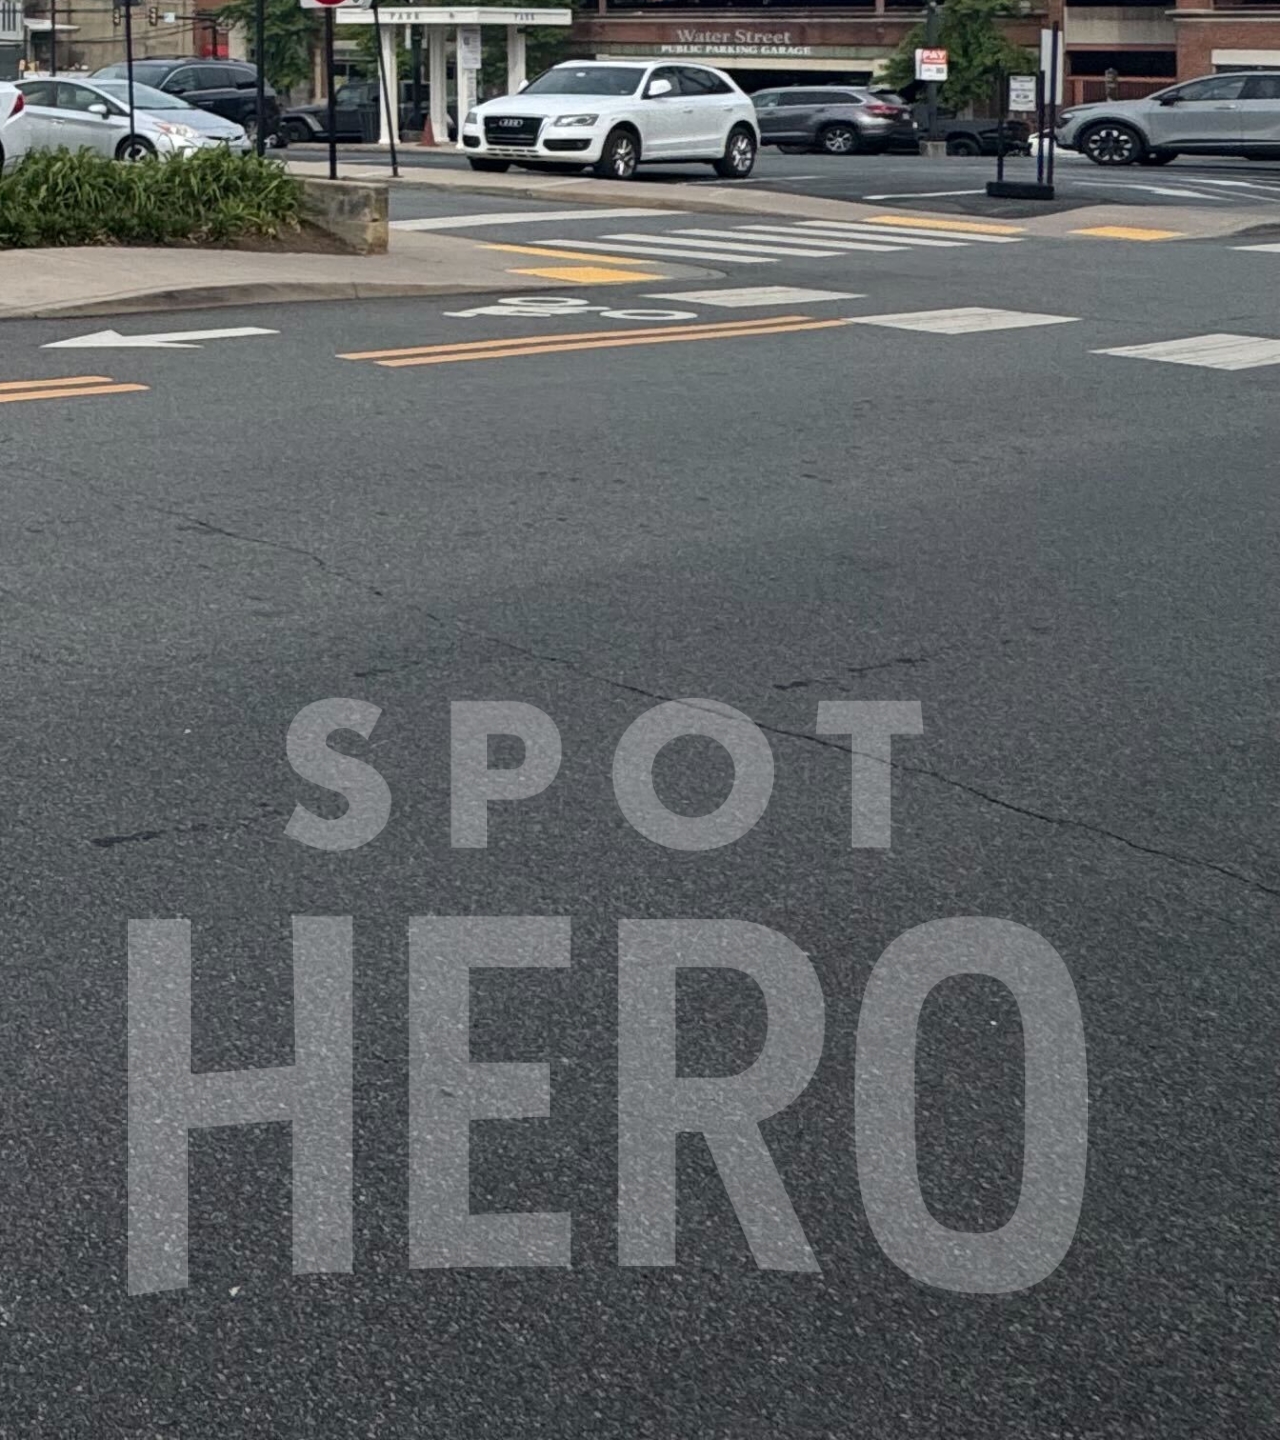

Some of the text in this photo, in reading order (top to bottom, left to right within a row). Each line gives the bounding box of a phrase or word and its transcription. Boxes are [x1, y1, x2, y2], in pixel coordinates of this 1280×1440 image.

[677, 28, 791, 44] Water Street
[661, 44, 811, 55] PUBLIC PARKING GARAGE
[922, 49, 947, 62] PAY
